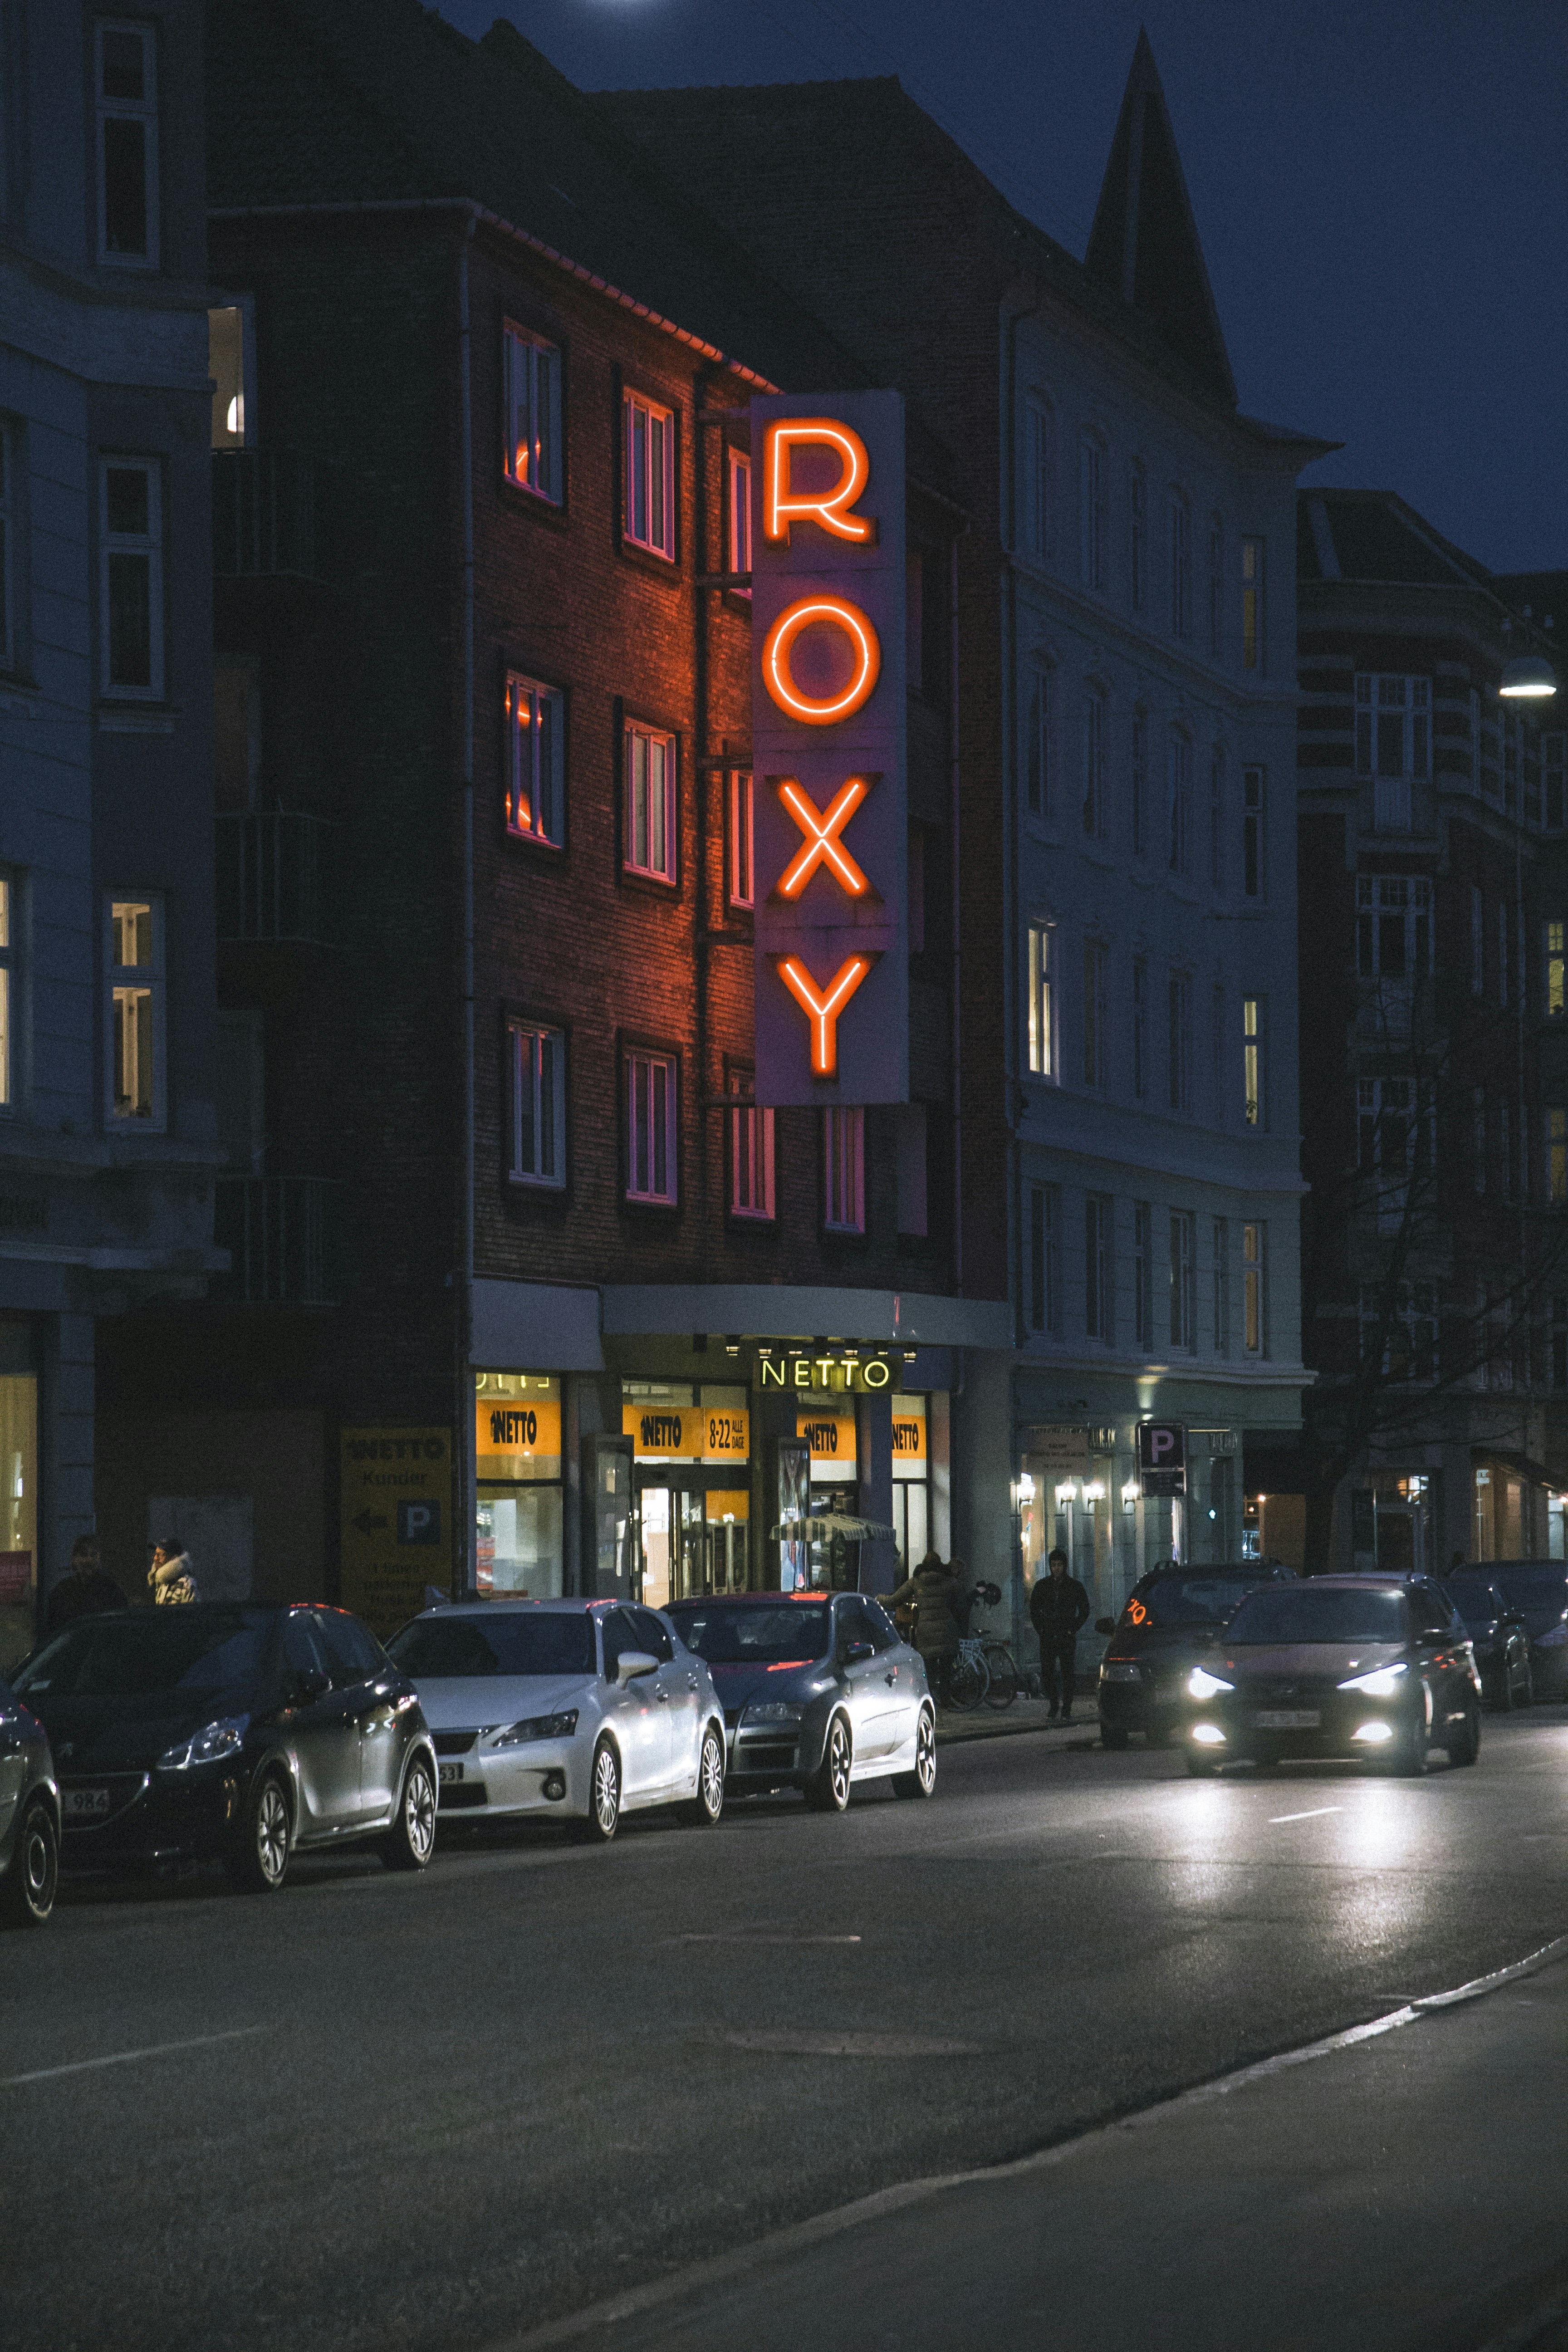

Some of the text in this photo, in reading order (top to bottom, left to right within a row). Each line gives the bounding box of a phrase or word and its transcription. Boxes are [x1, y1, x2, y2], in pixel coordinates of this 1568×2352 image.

[763, 416, 883, 1082] ROXY
[762, 1360, 889, 1387] NETTO
[492, 1410, 537, 1445] NETTO
[642, 1415, 682, 1448] NETTO
[710, 1418, 743, 1449] 8-22 ALLE
[732, 1436, 745, 1449] DAGE
[808, 1422, 838, 1453] NETTO
[892, 1422, 919, 1451] NETTO
[348, 1437, 445, 1460] NETTO
[1151, 1430, 1174, 1464] P
[363, 1470, 428, 1486] Kunder
[407, 1506, 431, 1539] P
